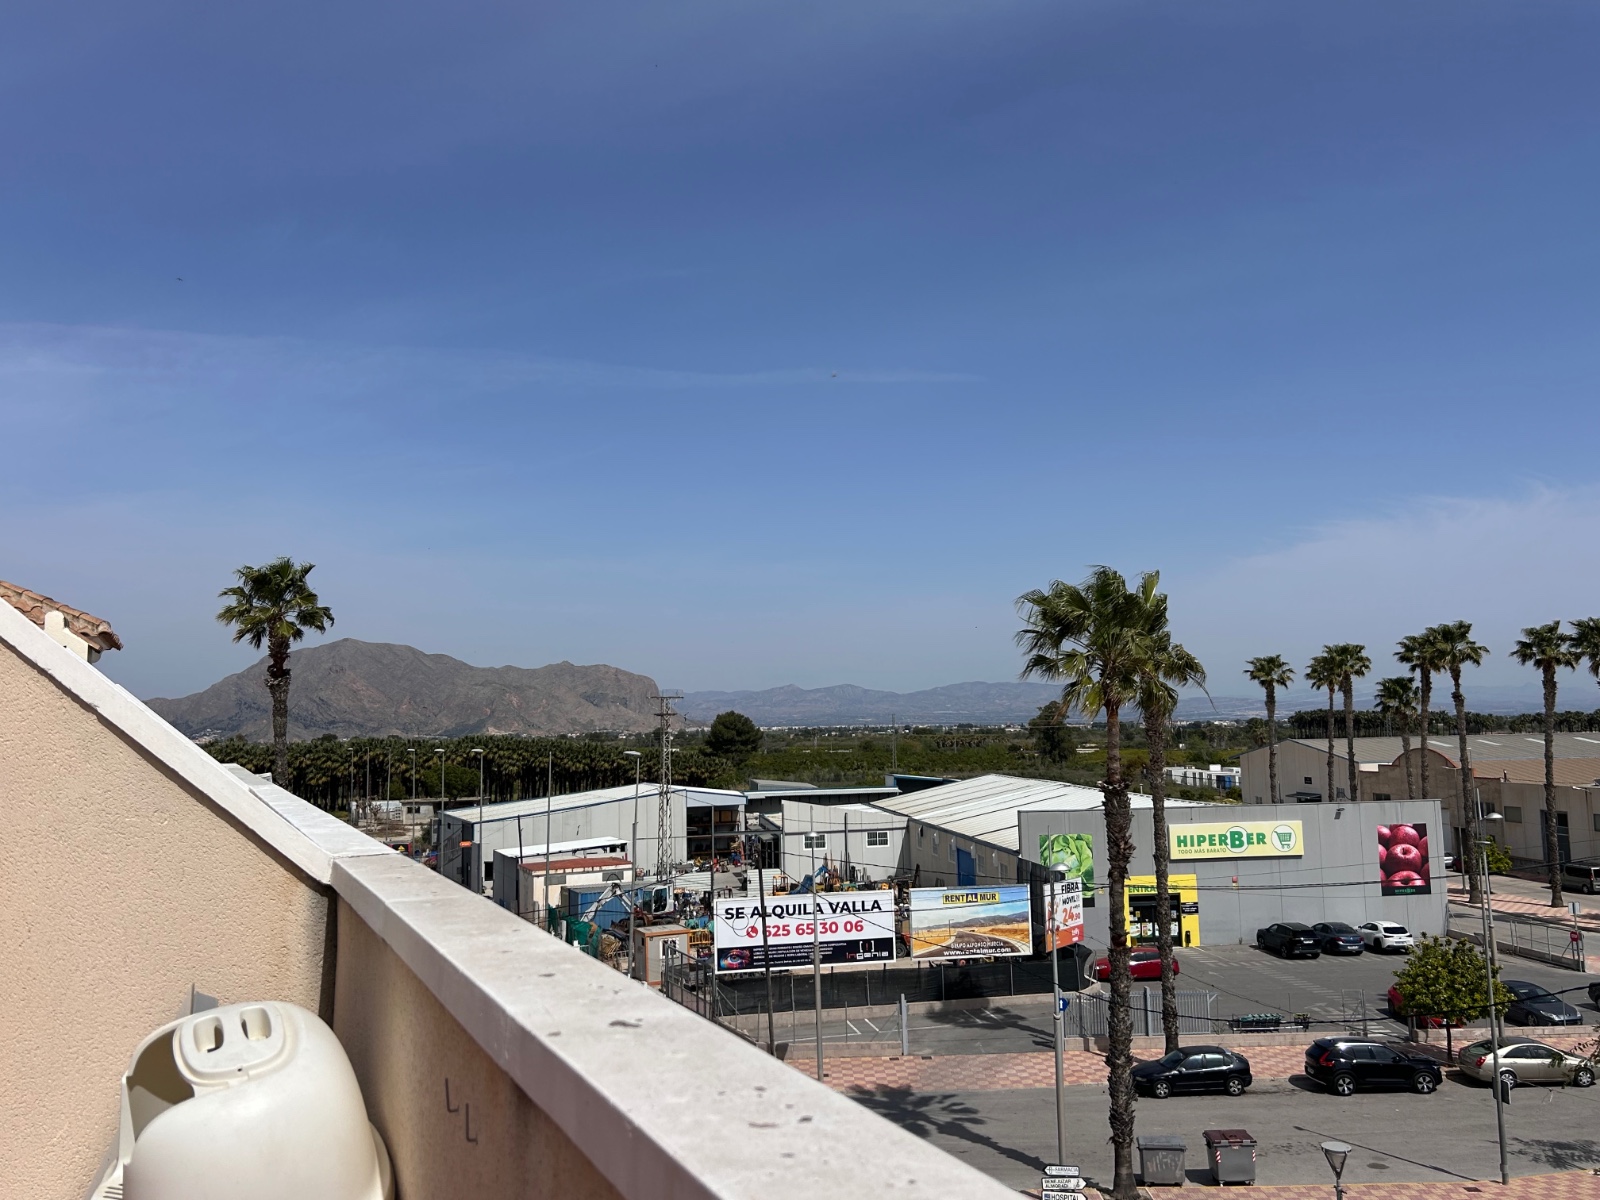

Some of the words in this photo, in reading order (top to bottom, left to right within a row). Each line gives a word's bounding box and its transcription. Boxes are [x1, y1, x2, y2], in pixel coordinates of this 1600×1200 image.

[1177, 830, 1267, 849] HIPERBER
[1061, 881, 1080, 894] FIBRA
[1128, 885, 1158, 893] ENTRA
[724, 907, 745, 920] SE
[750, 902, 824, 920] ALQUILA
[828, 899, 882, 914] VALLA
[795, 923, 815, 936] 65
[819, 921, 839, 935] 30
[843, 920, 864, 933] 06
